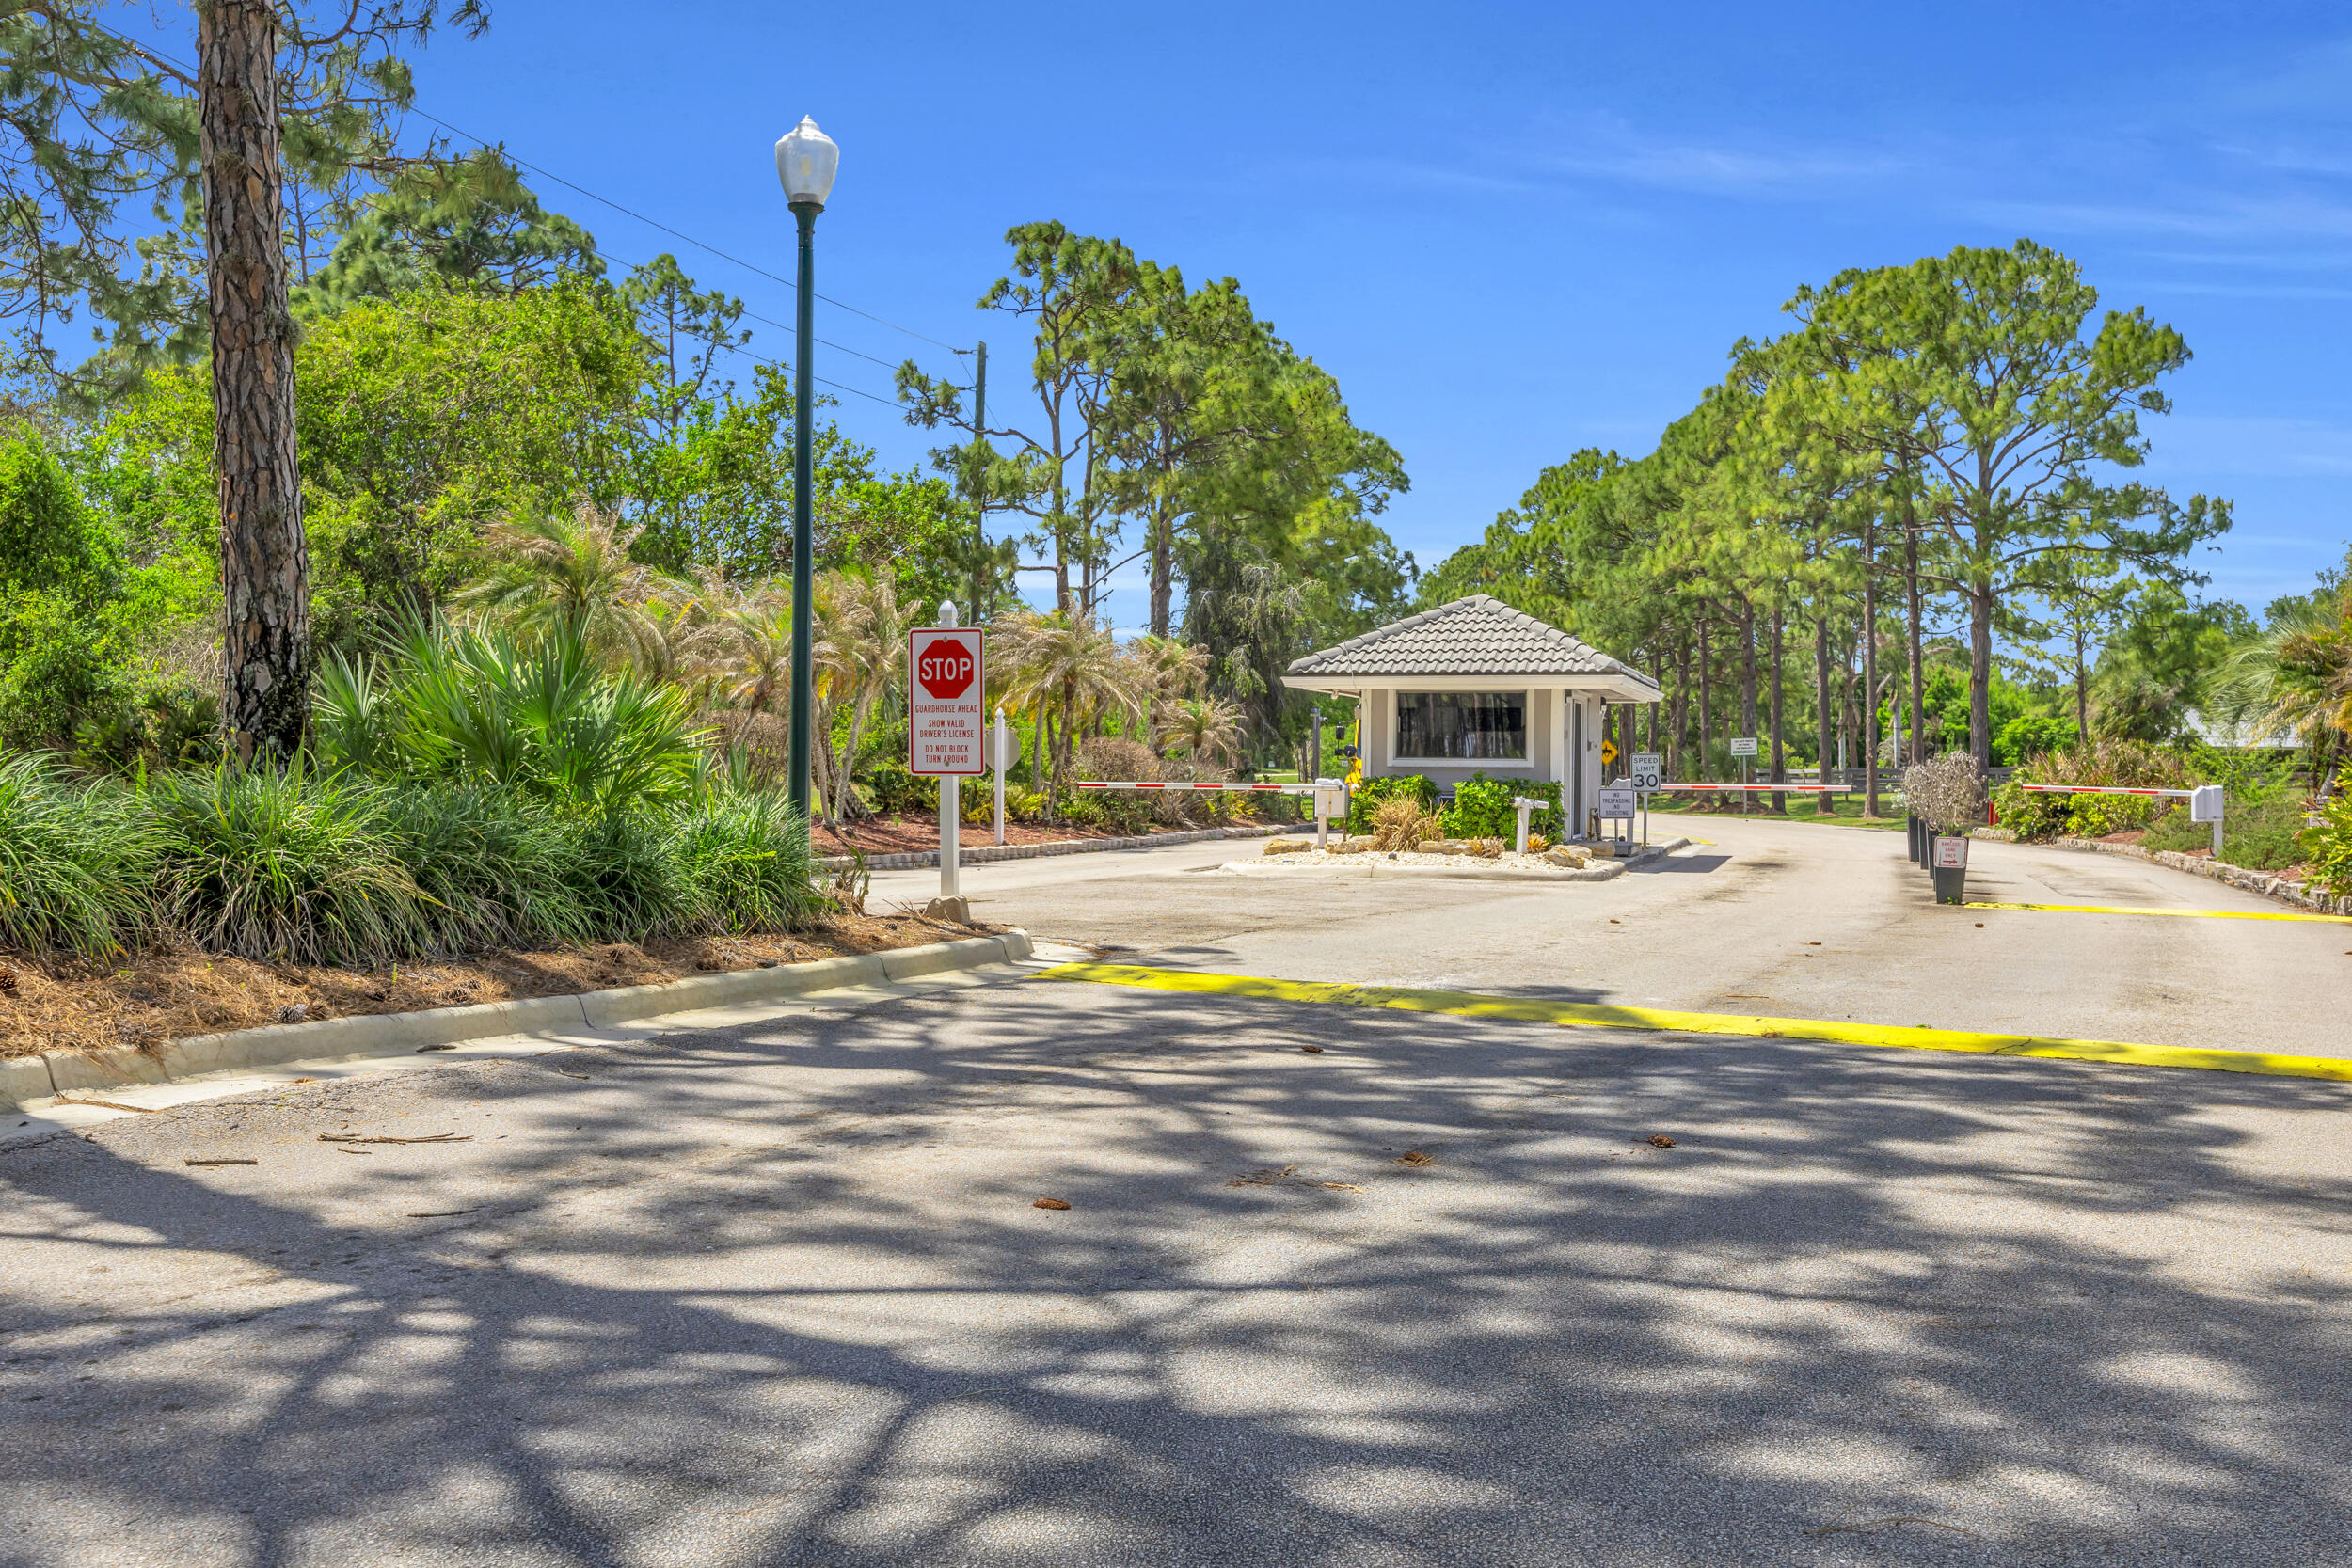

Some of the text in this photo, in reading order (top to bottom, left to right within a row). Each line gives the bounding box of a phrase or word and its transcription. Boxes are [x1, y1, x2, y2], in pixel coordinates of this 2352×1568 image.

[921, 658, 971, 681] STOP
[915, 705, 978, 713] GUARDHOUSE AHEAD
[920, 729, 974, 738] DRIVER'S LICENSE
[949, 744, 969, 753] BLOCK
[926, 755, 969, 763] TURN AROUND
[1634, 774, 1658, 788] 30
